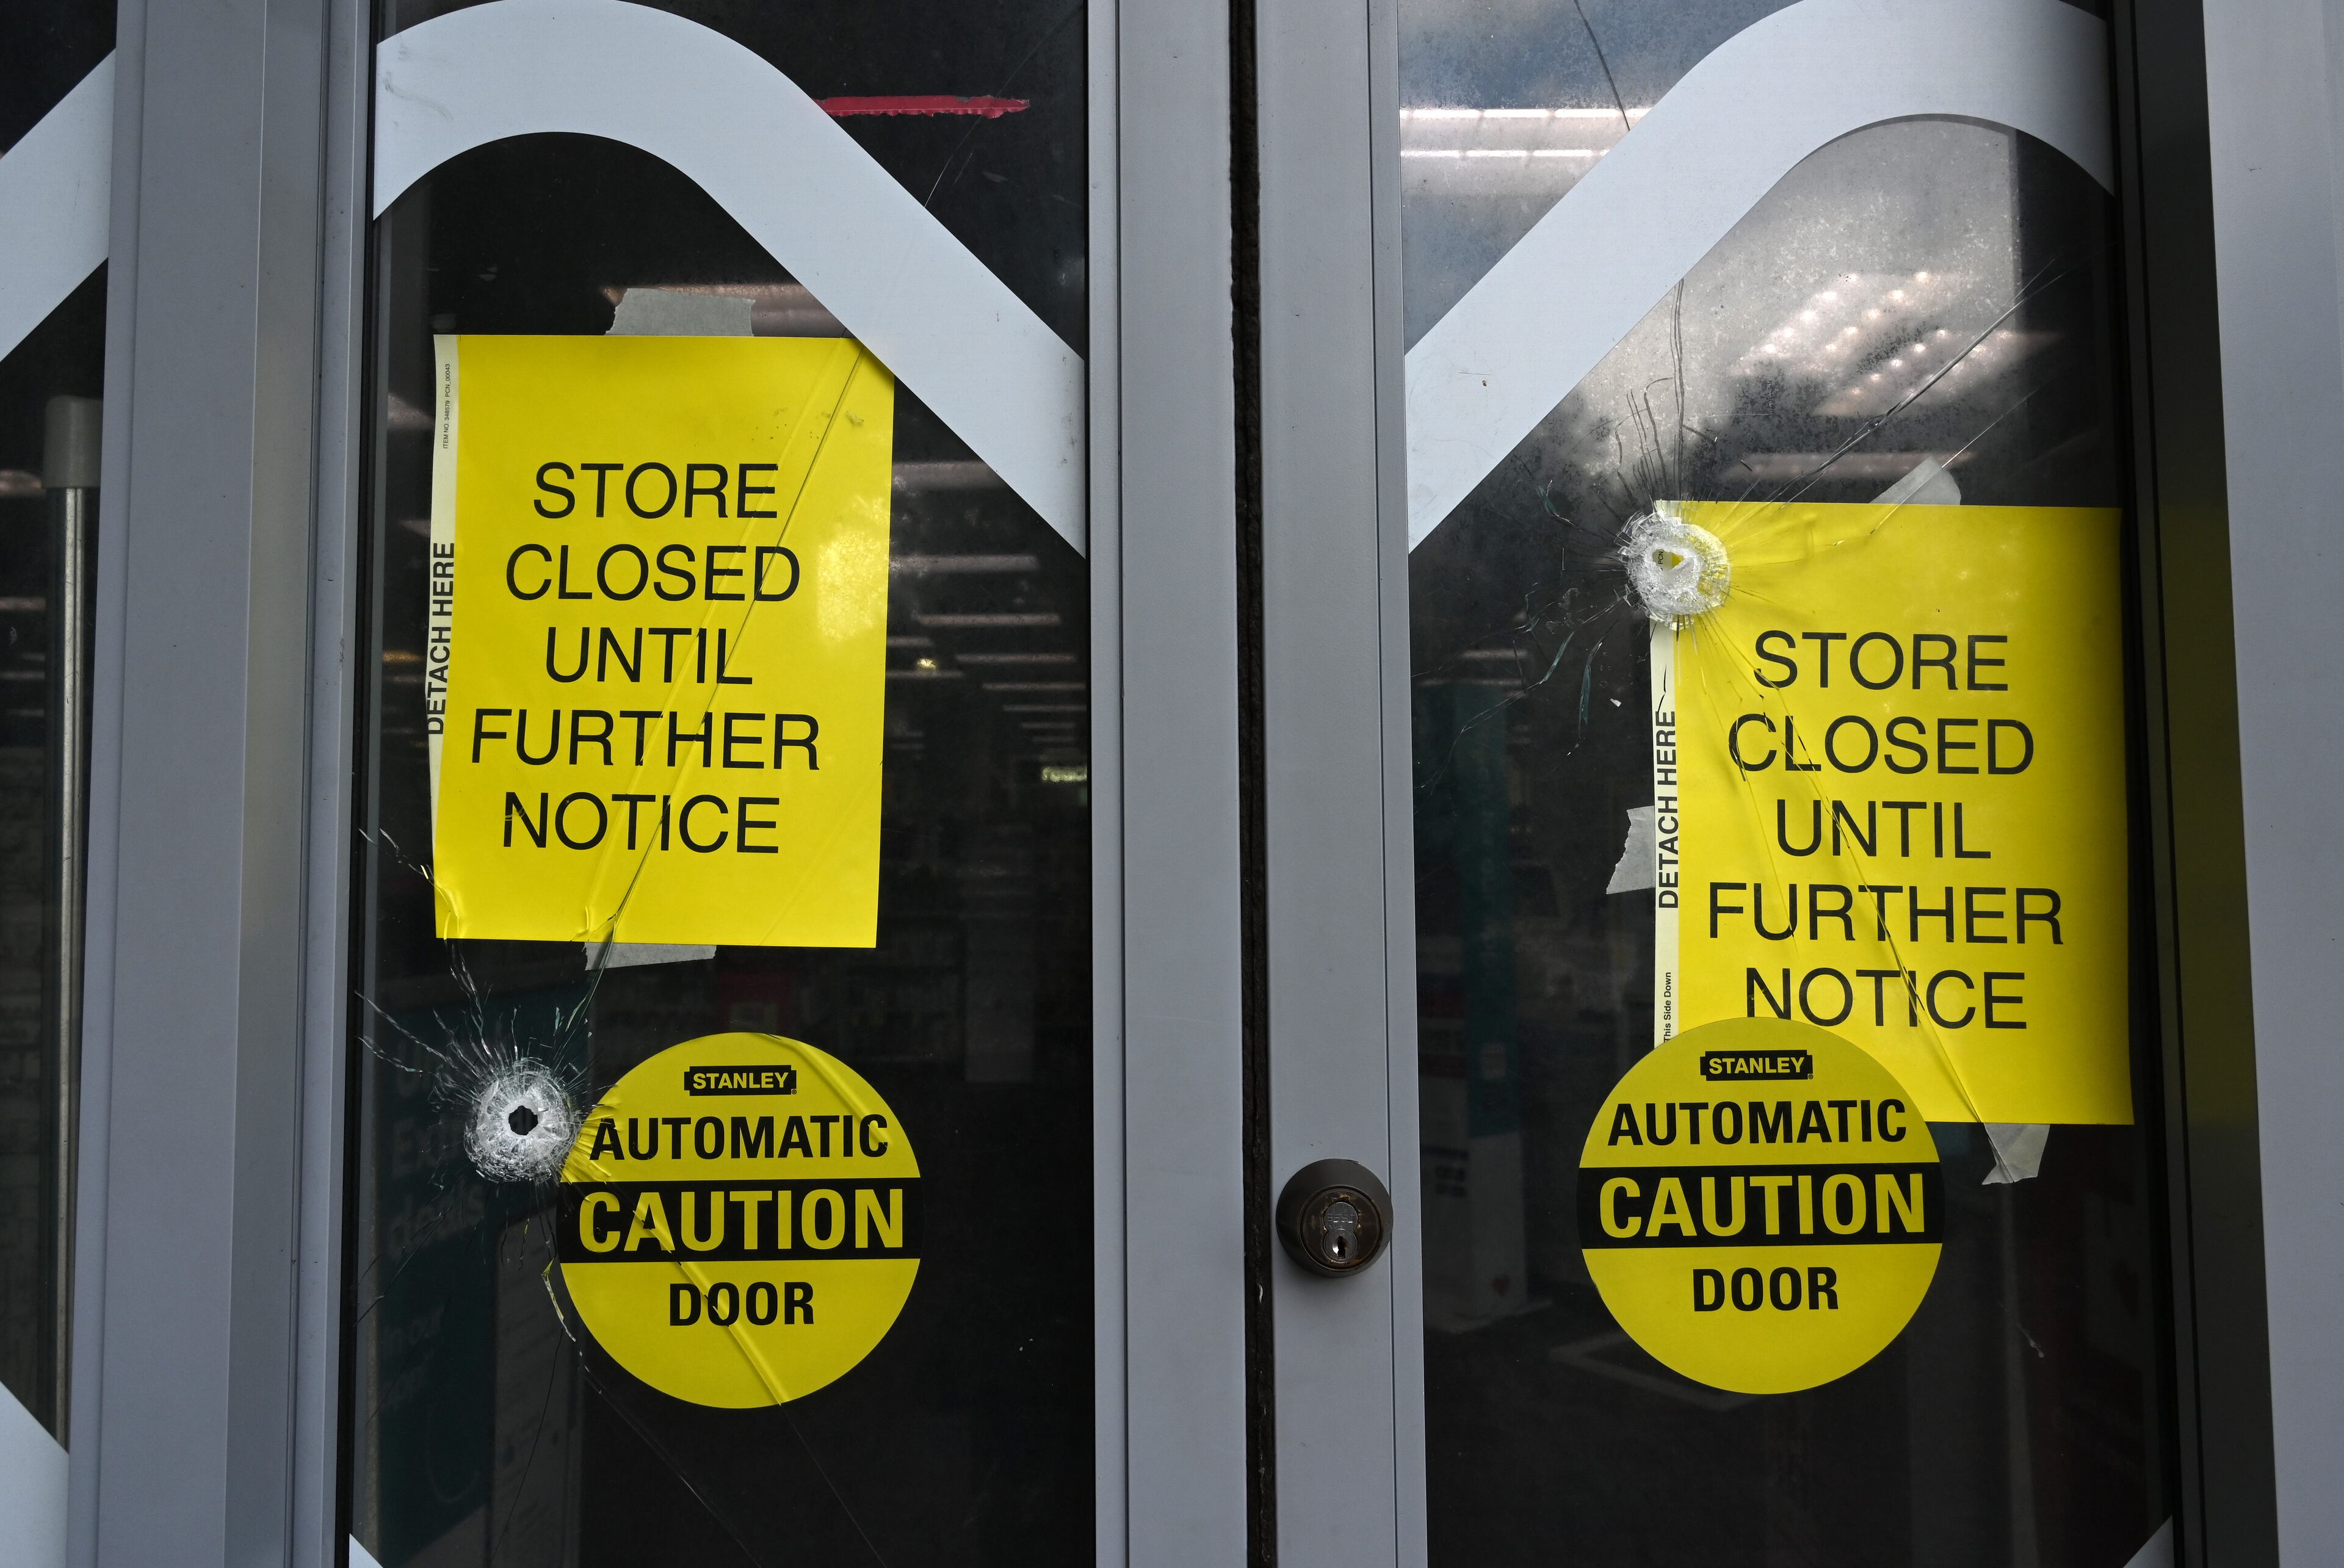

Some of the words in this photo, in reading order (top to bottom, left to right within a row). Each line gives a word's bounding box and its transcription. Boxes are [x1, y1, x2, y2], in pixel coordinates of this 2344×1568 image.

[534, 462, 778, 519] STORE
[432, 543, 455, 616] HERE
[507, 544, 800, 601] CLOSED
[427, 626, 452, 735] DETACH
[546, 627, 752, 684] UNTIL
[1754, 630, 2008, 691] STORE
[472, 709, 819, 770] FURTHER
[1655, 710, 1677, 786] HERE
[1729, 712, 2033, 773] CLOSED
[504, 792, 779, 853] NOTICE
[1658, 796, 1679, 909] DETACH
[1778, 800, 1991, 858] UNTIL
[1710, 883, 2063, 945] FURTHER
[1747, 968, 2027, 1029] NOTICE
[693, 1072, 789, 1089] STANLEY
[1709, 1057, 1805, 1074] STANLEY
[589, 1114, 888, 1160] AUTOMATIC
[1608, 1099, 1906, 1146] AUTOMATIC
[579, 1188, 903, 1253] CAUTION
[1599, 1173, 1925, 1238] CAUTION
[670, 1282, 814, 1327] DOOR
[1693, 1267, 1838, 1311] DOOR
